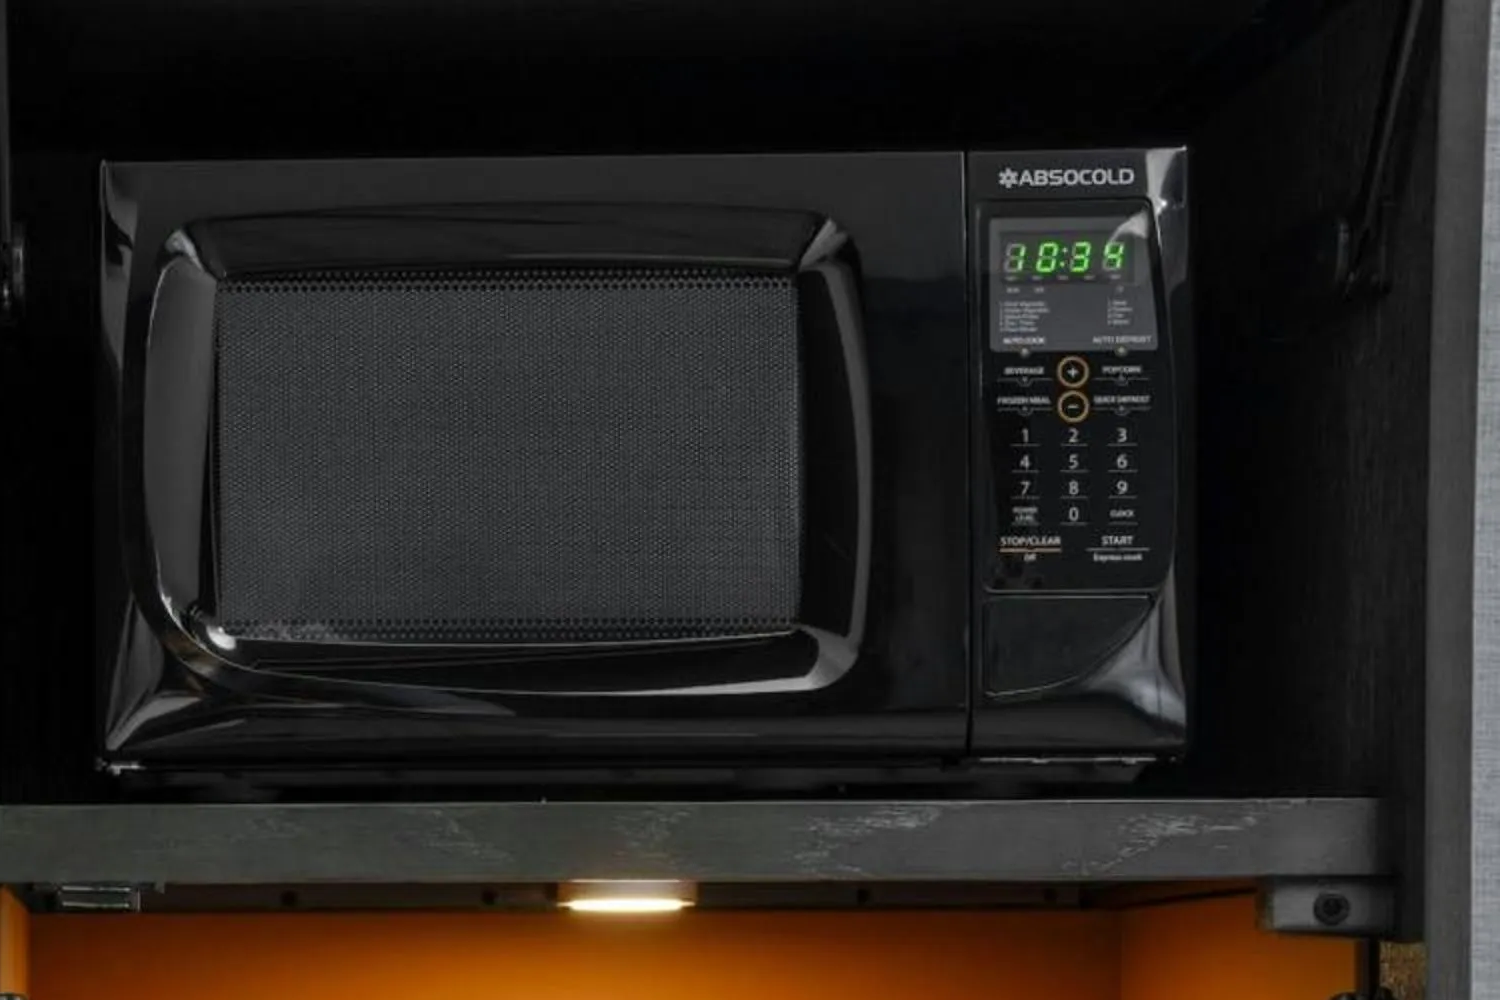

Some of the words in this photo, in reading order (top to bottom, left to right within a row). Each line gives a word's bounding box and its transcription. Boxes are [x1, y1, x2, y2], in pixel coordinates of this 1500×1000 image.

[1019, 168, 1134, 186] ABSOCOLD
[1017, 241, 1125, 273] 10:34
[1021, 428, 1029, 443] 1
[1069, 428, 1079, 443] 2
[1117, 428, 1127, 443] 3
[1020, 455, 1030, 470] 4
[1069, 455, 1079, 470] 5
[1117, 455, 1127, 469] 6
[1020, 481, 1030, 495] 7
[1069, 481, 1079, 495] 8
[1116, 481, 1128, 495] 9
[1069, 507, 1079, 521] 0
[1000, 535, 1061, 546] STOP/CLEAR
[1102, 535, 1133, 546] START
